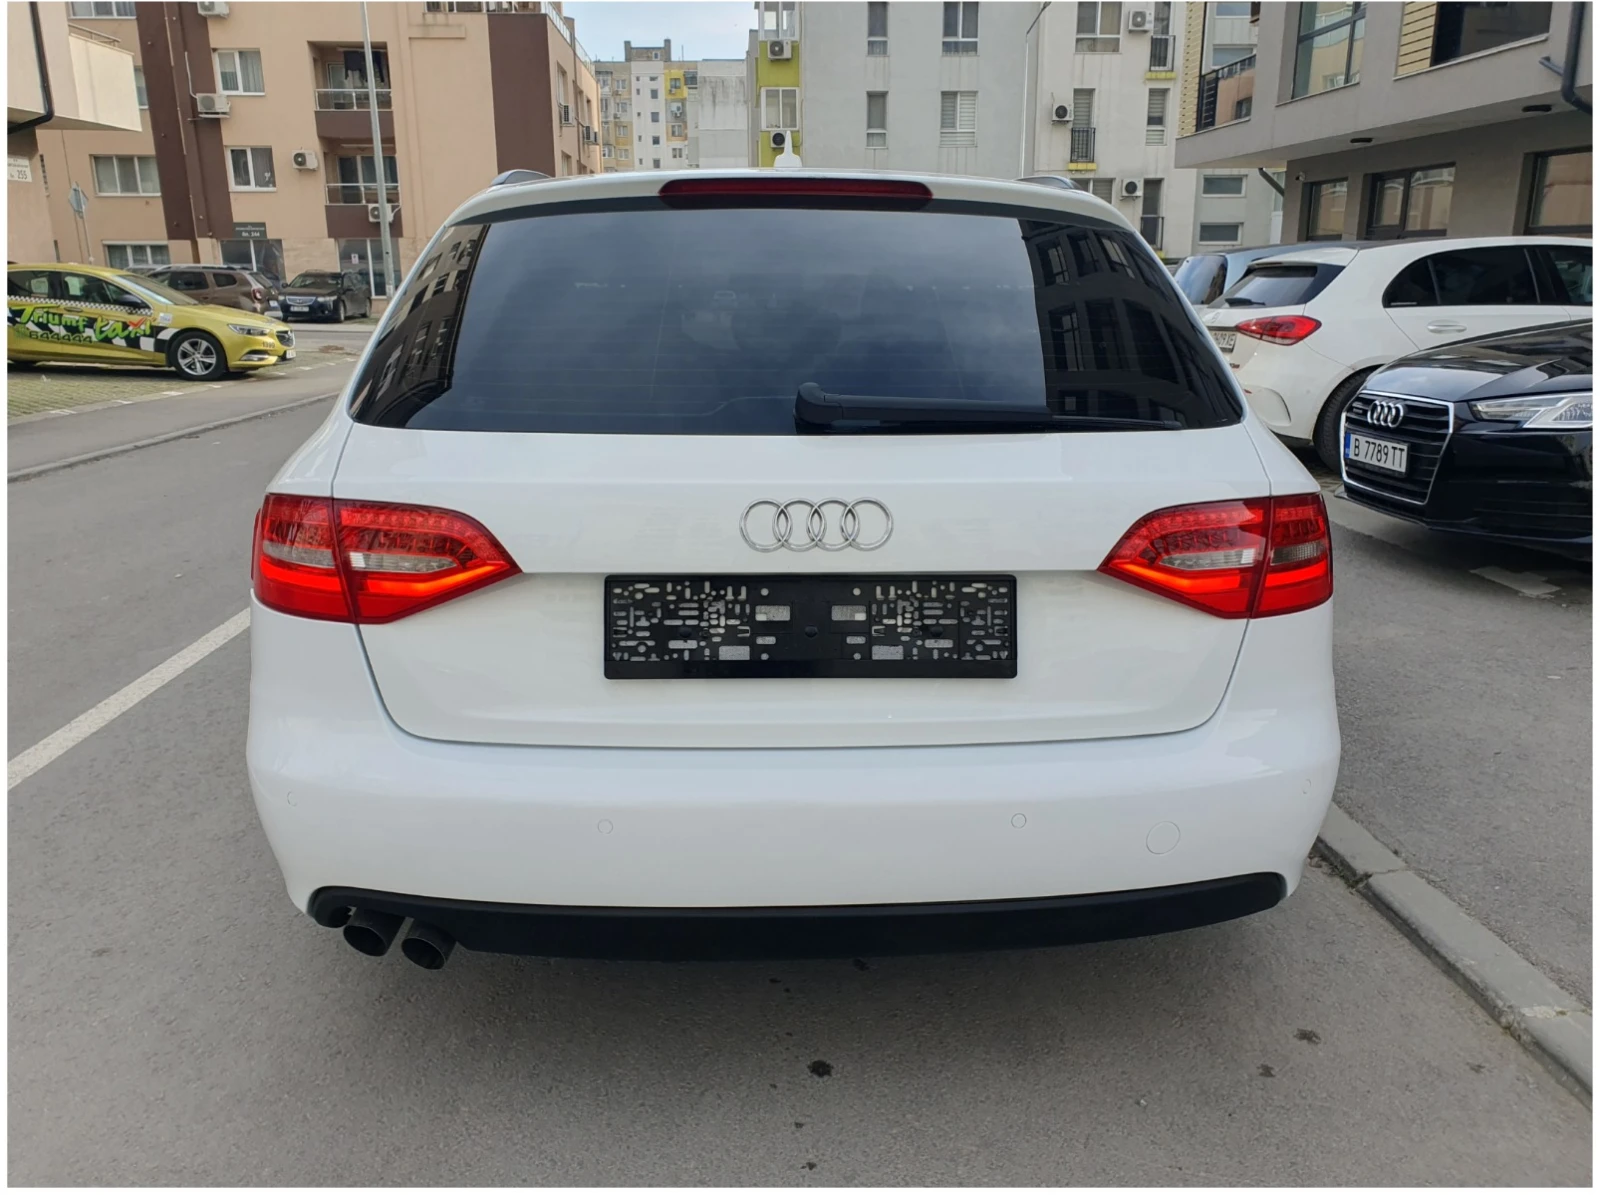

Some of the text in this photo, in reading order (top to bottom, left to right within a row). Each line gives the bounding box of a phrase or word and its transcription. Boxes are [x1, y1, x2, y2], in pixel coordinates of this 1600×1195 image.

[9, 304, 152, 341] Triumf taxi
[1354, 438, 1405, 469] B 7789 TT
